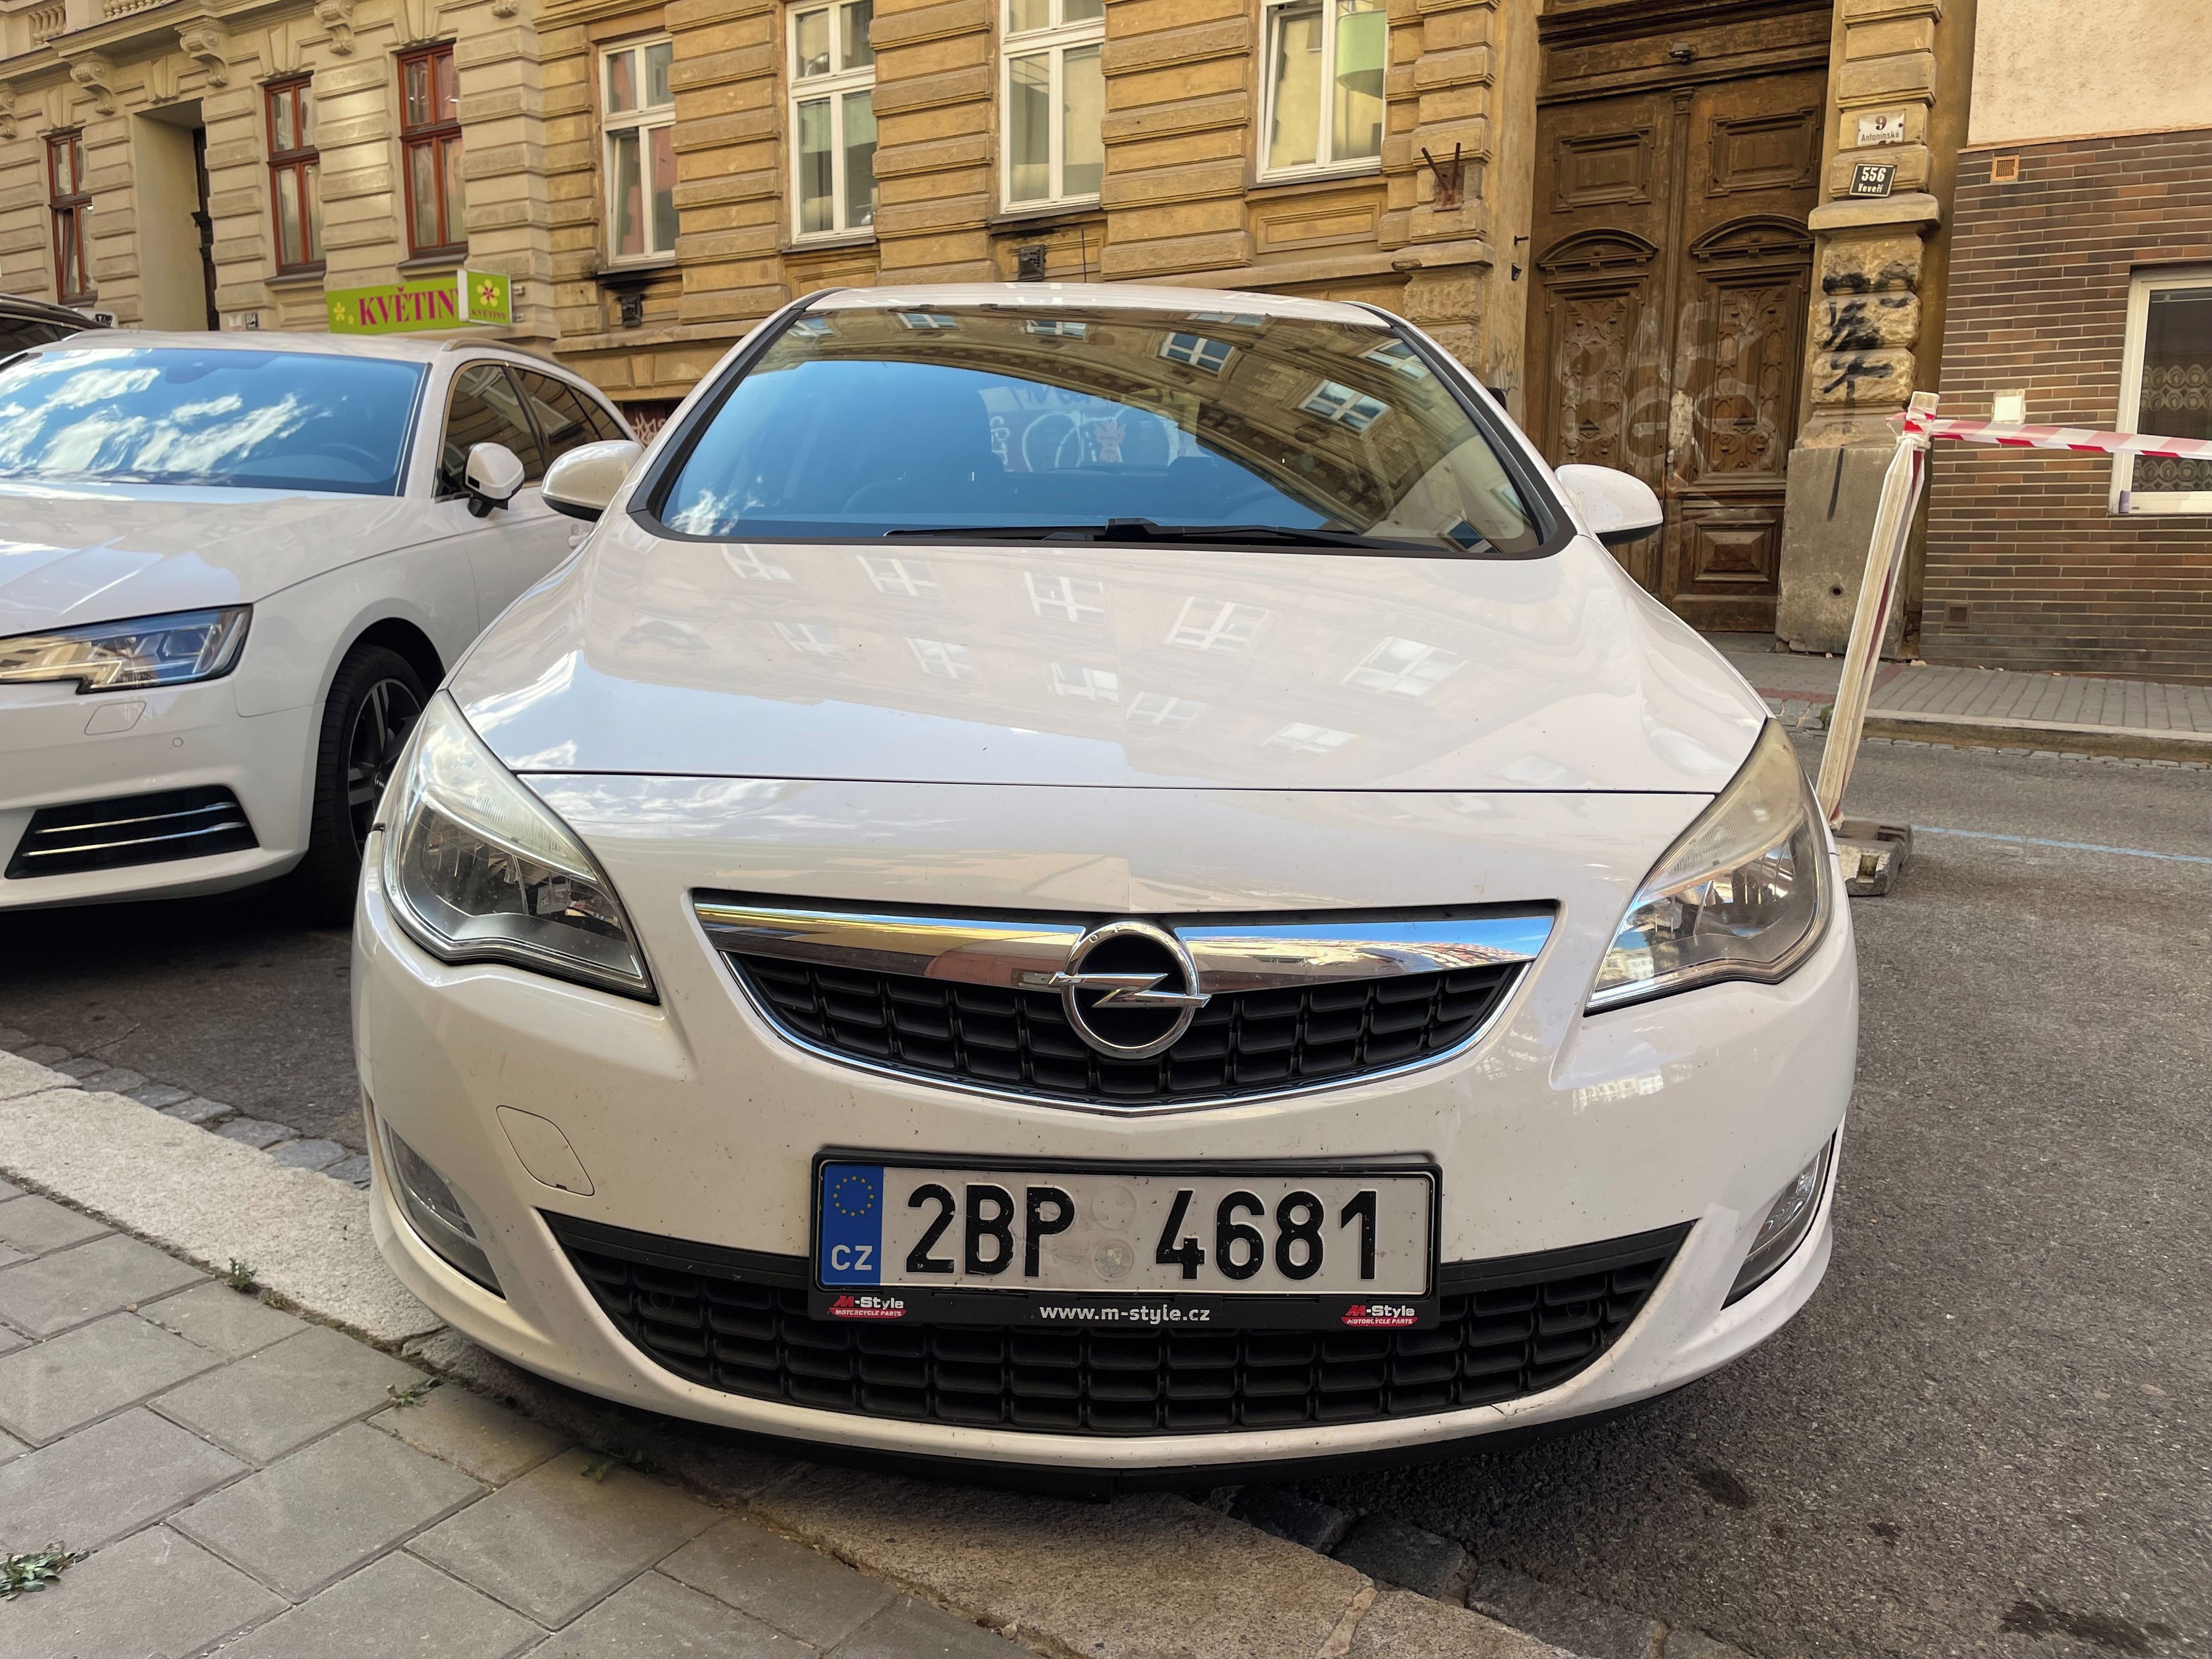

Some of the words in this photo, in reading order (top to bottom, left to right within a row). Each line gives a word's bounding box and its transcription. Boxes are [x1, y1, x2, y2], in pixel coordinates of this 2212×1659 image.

[1875, 115, 1887, 130] 9
[1861, 166, 1887, 182] 556
[358, 285, 459, 326] KVĚTIN
[905, 1183, 1076, 1278] 2BP
[1155, 1189, 1378, 1281] 4681
[831, 1244, 873, 1271] CZ
[833, 1295, 905, 1310] M-Style
[1345, 1305, 1415, 1318] M-Style
[1039, 1304, 1211, 1325] www.m-style.cz
